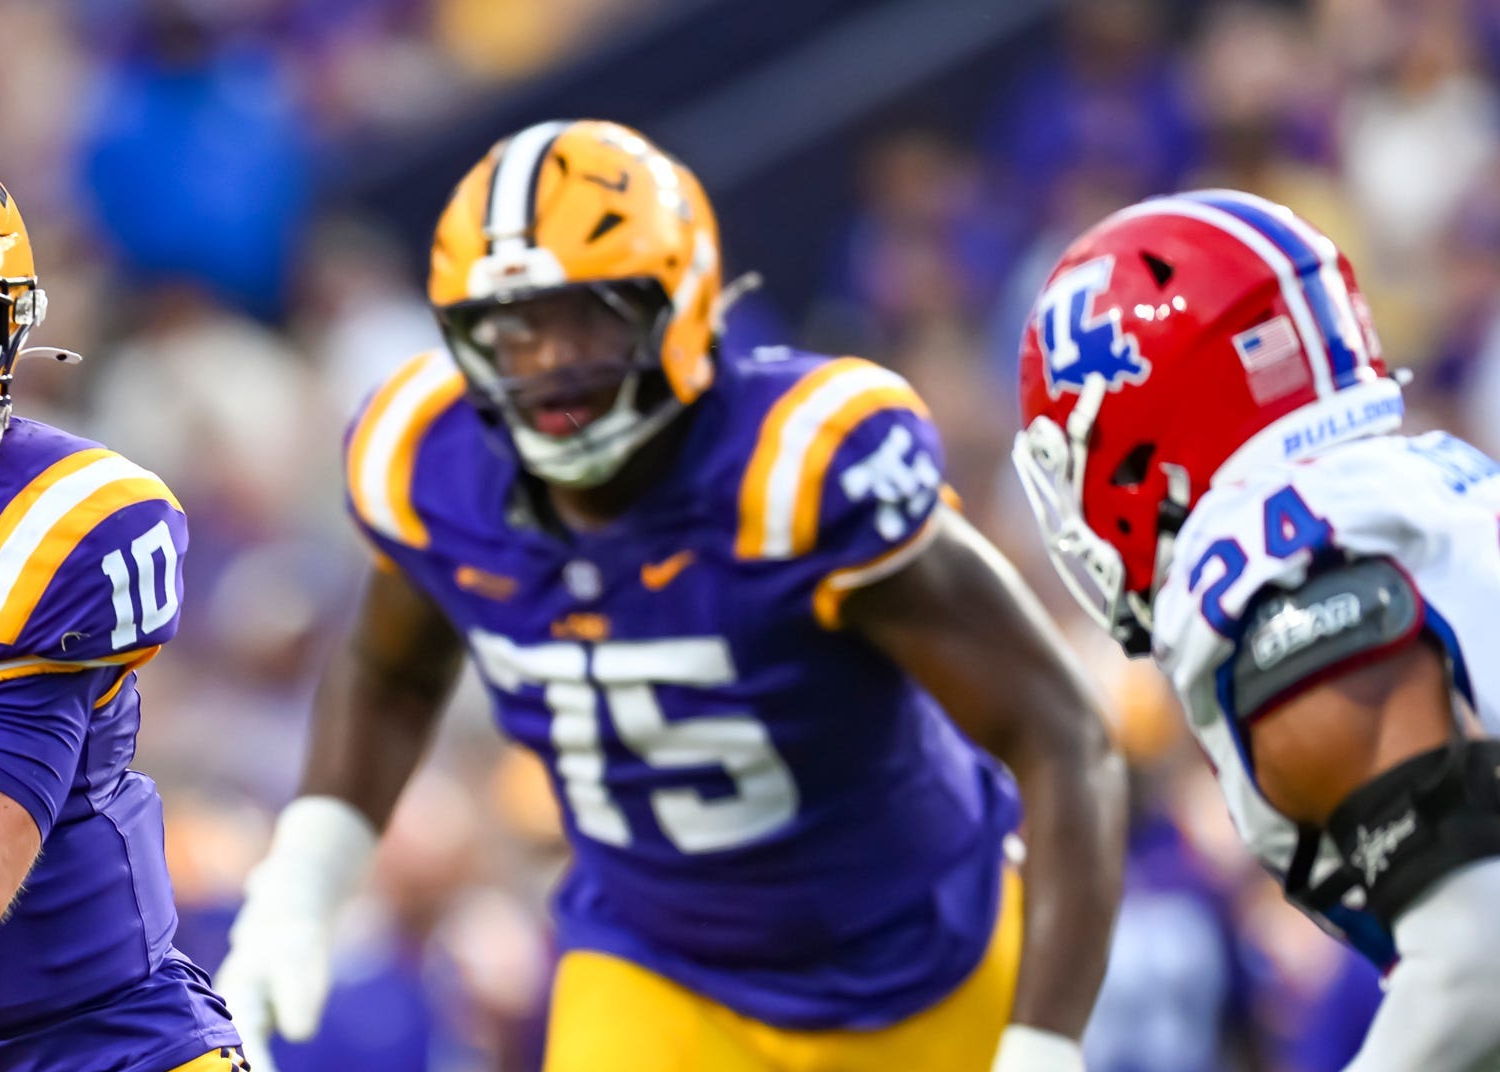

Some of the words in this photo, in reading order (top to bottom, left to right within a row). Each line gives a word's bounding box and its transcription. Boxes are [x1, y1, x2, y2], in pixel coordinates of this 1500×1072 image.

[101, 520, 178, 650] 10
[1189, 484, 1335, 640] 24
[469, 627, 800, 854] 75
